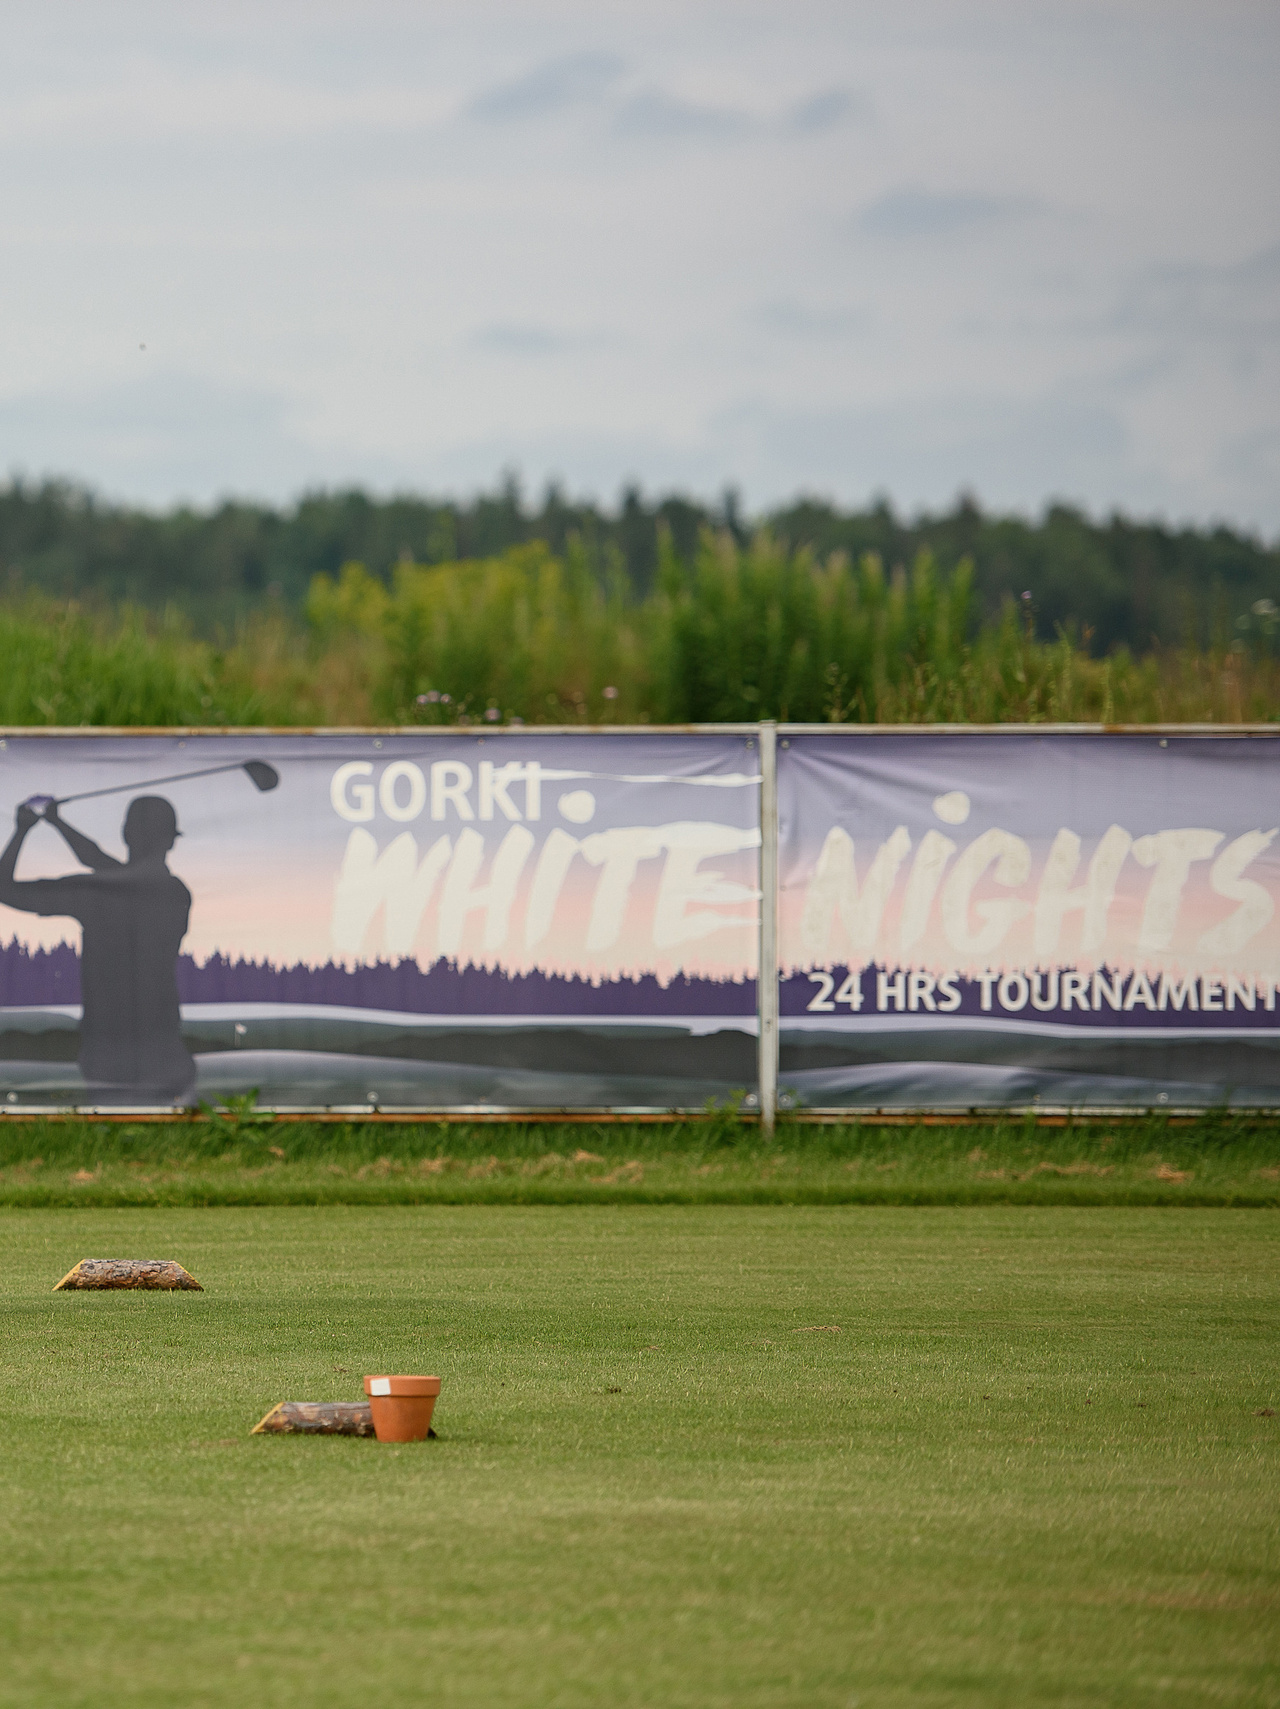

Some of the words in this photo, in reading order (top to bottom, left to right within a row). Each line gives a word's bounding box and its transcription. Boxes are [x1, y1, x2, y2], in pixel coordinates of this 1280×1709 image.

[330, 760, 542, 823] GORKI
[806, 971, 865, 1013] 24
[876, 971, 962, 1013] HRS
[974, 969, 1280, 1013] TOURNAMENT
